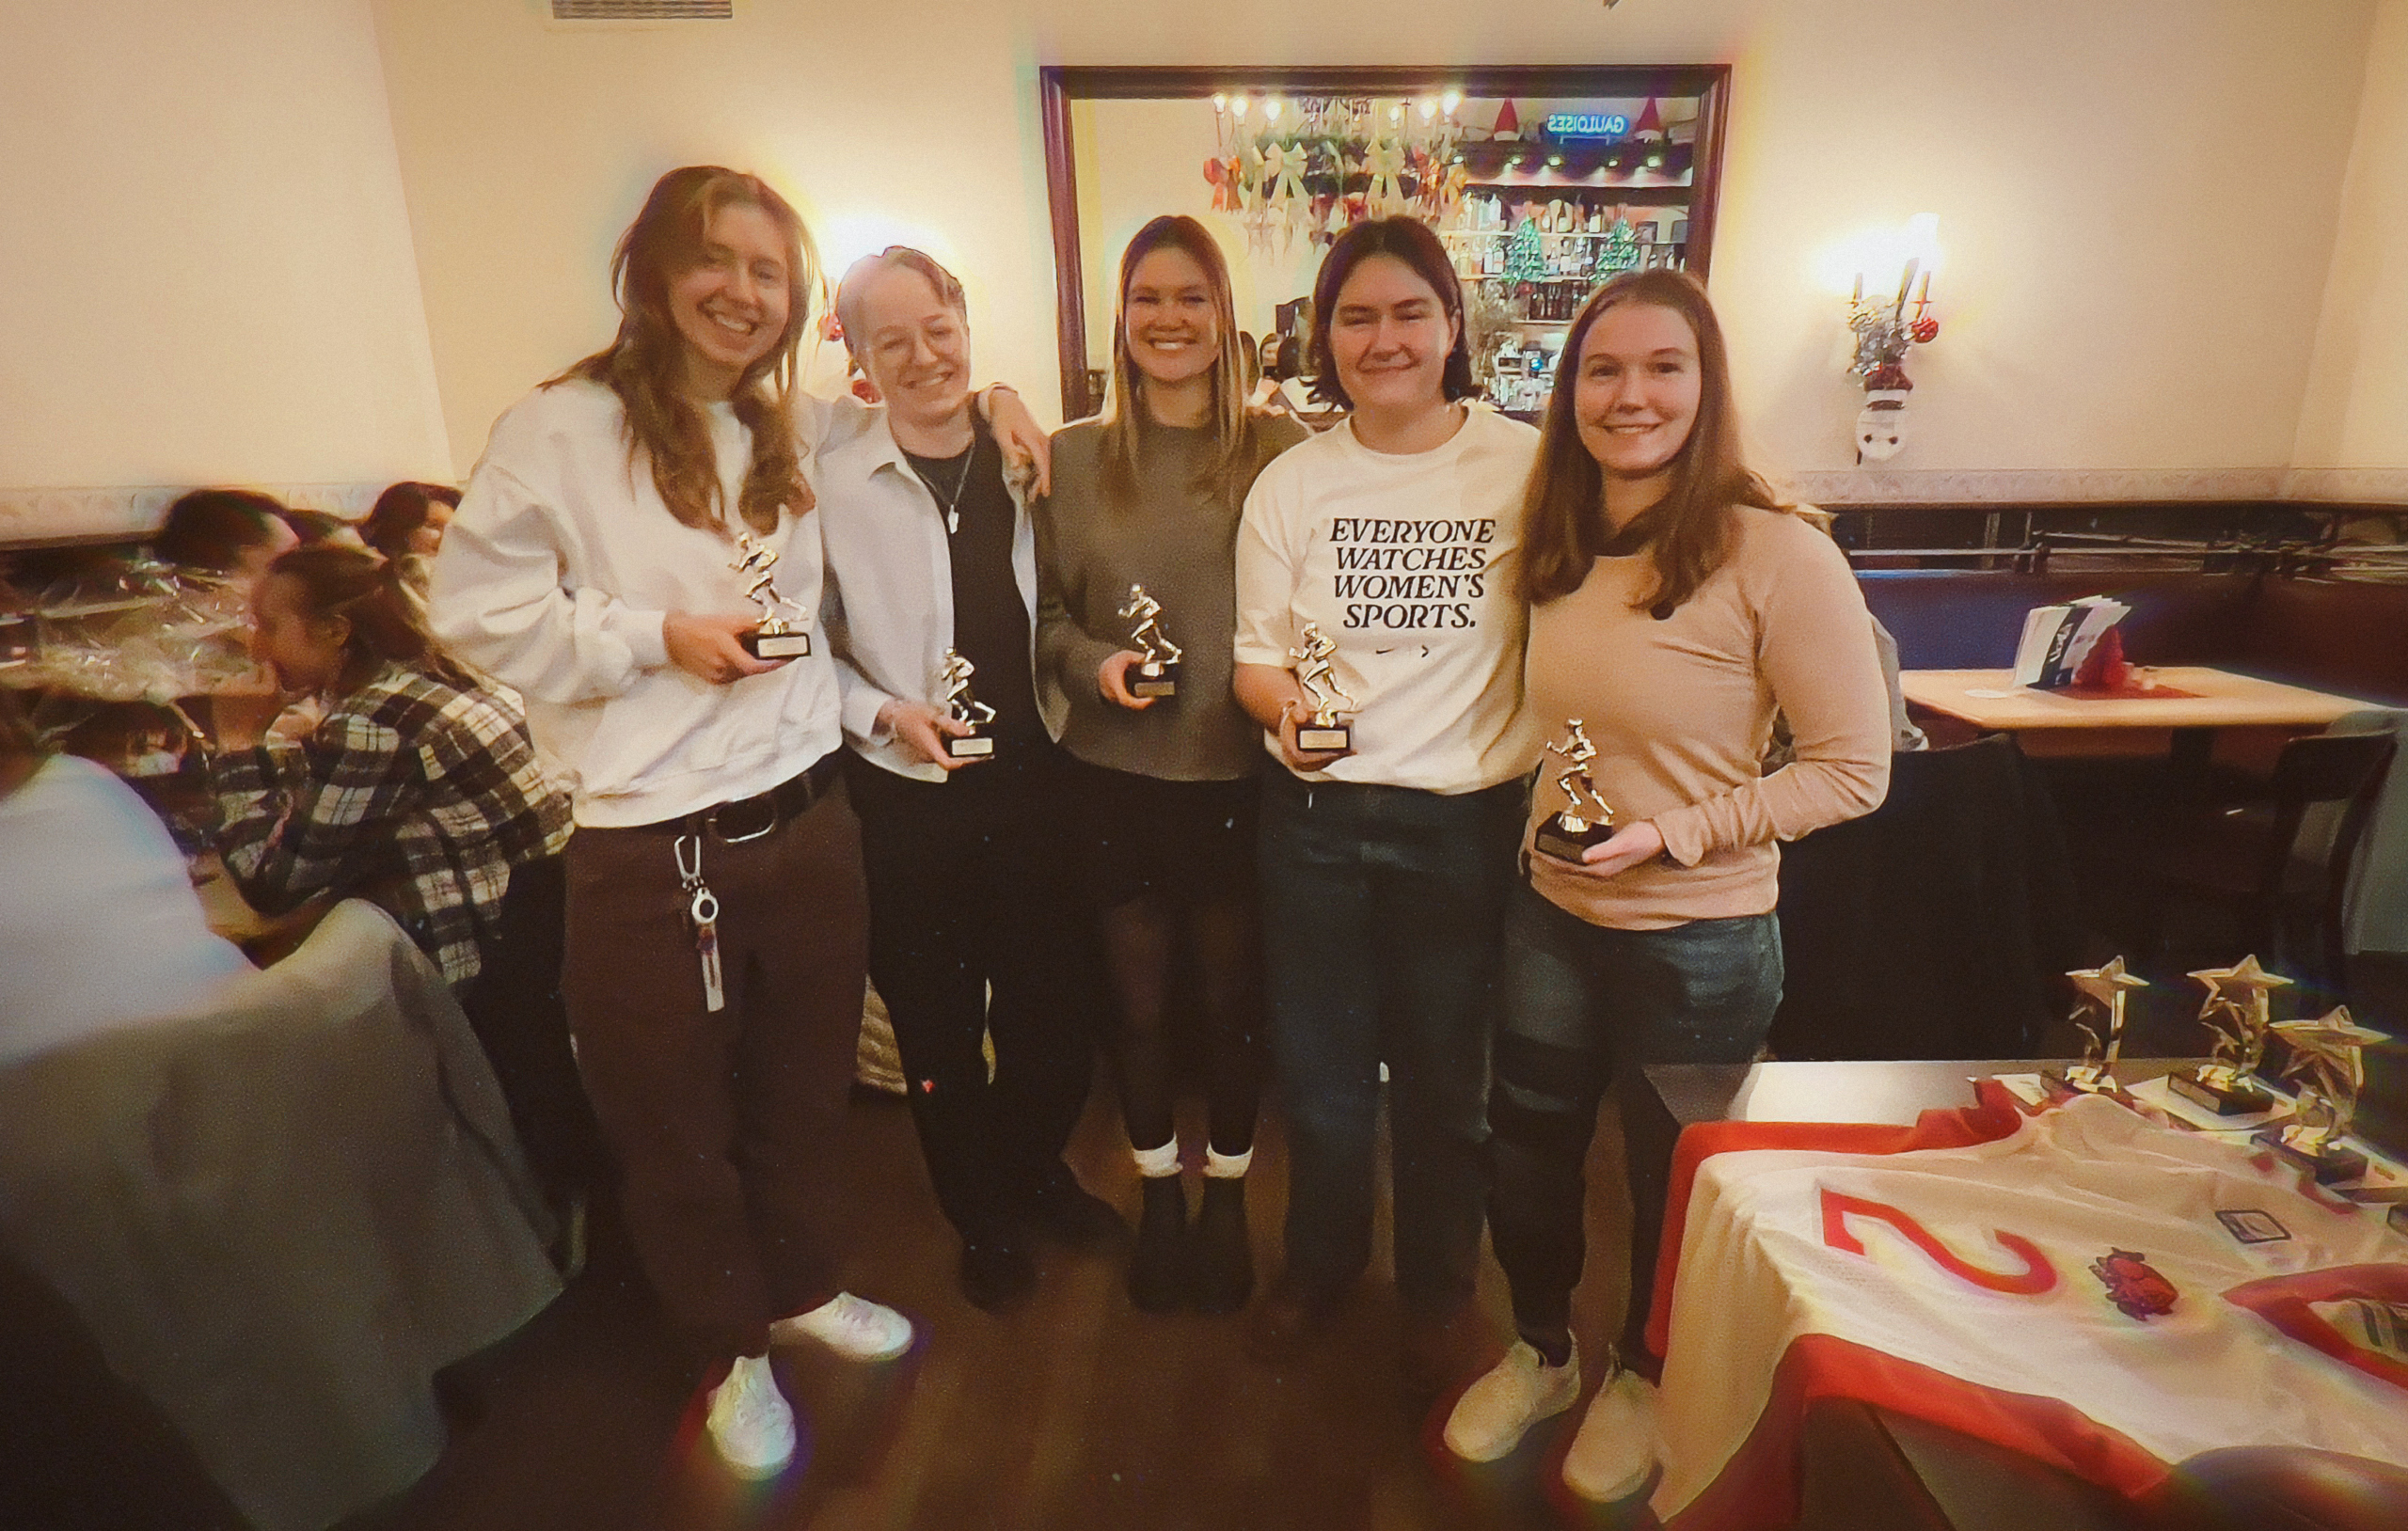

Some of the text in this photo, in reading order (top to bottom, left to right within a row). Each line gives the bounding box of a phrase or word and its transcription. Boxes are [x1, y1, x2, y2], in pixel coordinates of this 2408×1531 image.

[1329, 518, 1496, 544] EVERYONE
[1337, 546, 1486, 571] WATCHES
[1334, 574, 1484, 599] WOMEN'S
[1343, 604, 1476, 628] SPORTS.
[1820, 1188, 2057, 1295] 2
